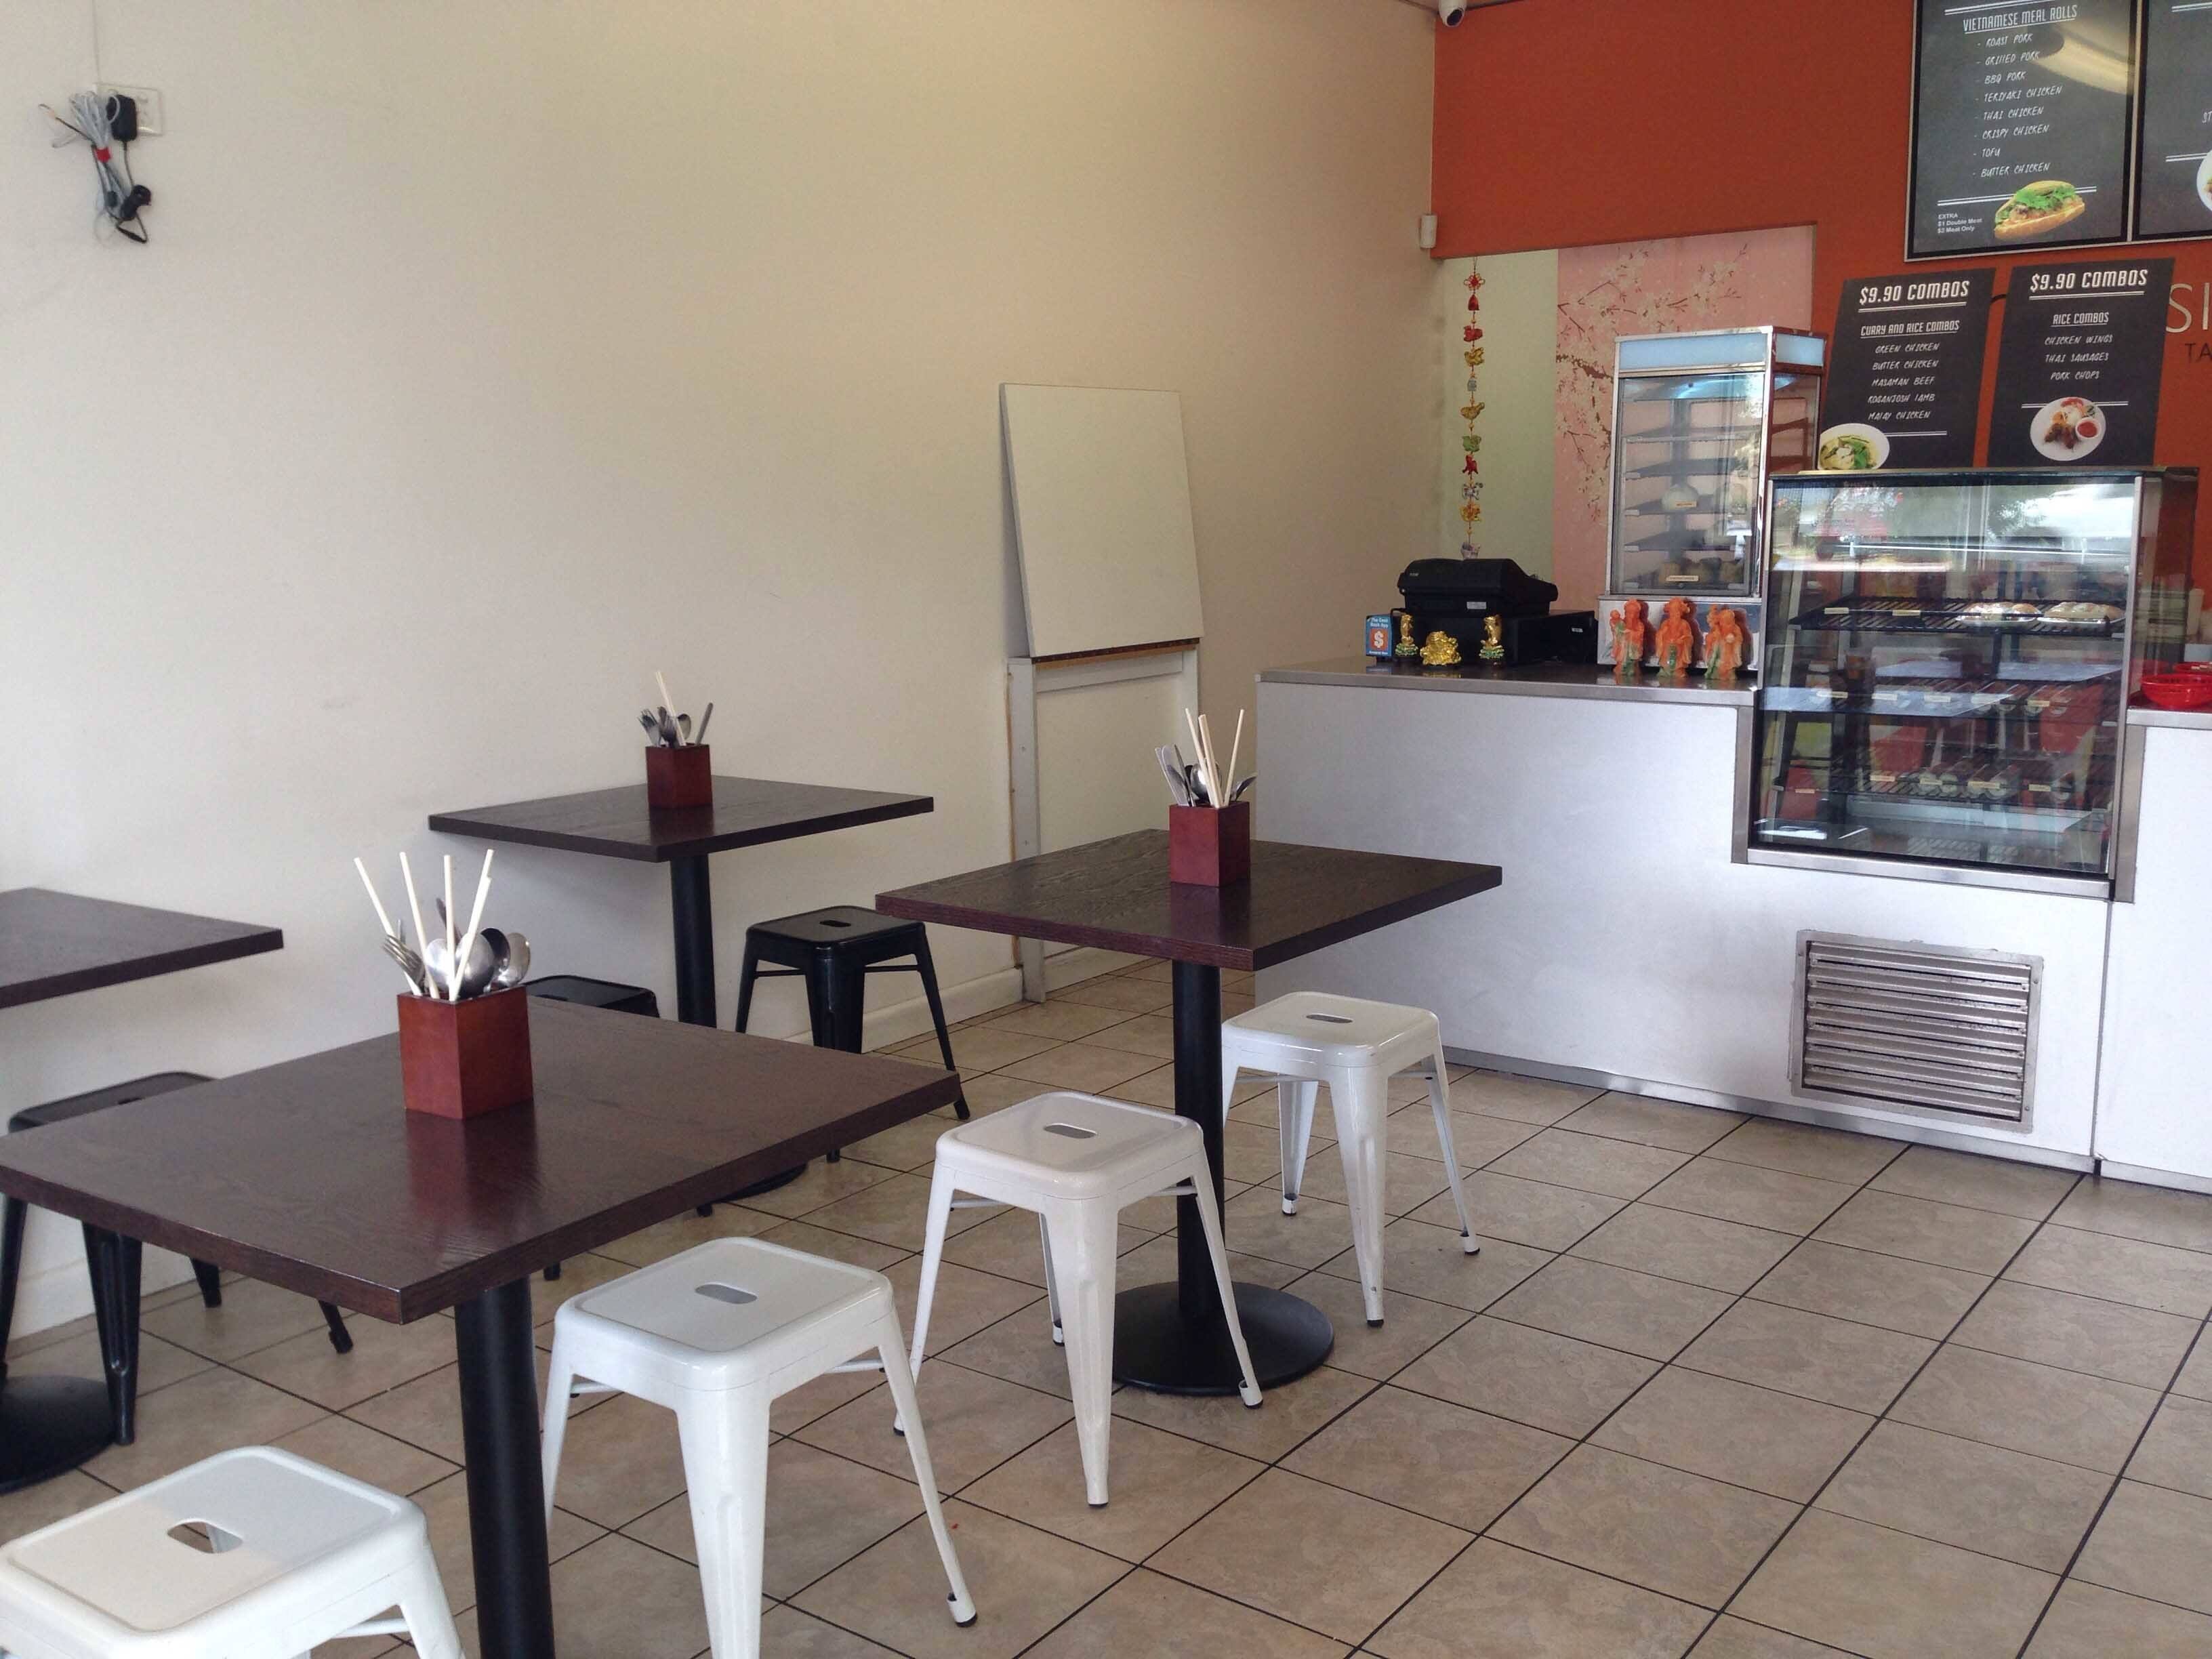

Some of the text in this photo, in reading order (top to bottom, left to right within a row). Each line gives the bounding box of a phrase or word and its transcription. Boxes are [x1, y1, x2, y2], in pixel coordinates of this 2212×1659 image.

[1963, 5, 2078, 31] VIETNAMESE MEAL ROLLS
[1986, 34, 2033, 47] ROAST PORK
[1985, 51, 2041, 66] GRILLED PORK
[1984, 71, 2027, 84] BBQ PORK
[1984, 85, 2063, 102] TERIYAKI CHICKEN
[1984, 106, 2044, 120] THAI CHICKEN
[1982, 124, 2049, 140] CRISPY CHICKEN
[1982, 148, 2001, 157] TOFU
[1981, 163, 2051, 177] BUTTER CHICKEN
[2030, 269, 2148, 293] $9.90 COMBOS
[1859, 281, 1970, 305] $9.90 COMBOS
[2053, 312, 2109, 325] RICE COMBOS
[1860, 320, 1960, 336] CURRY AND RICE COMBOS
[2045, 334, 2113, 346] CHICKEN WINGS
[1875, 343, 1940, 354] GREEN CHICKEN
[2045, 352, 2109, 363] THAI SAUSAGES
[1872, 359, 1939, 370] BUTTER CHICKEN
[1871, 375, 1936, 387] MASAMAN BEEF
[2051, 371, 2100, 380] PORK CHOPS
[1914, 393, 1936, 402] LAMB
[1896, 410, 1931, 419] CHICKEN
